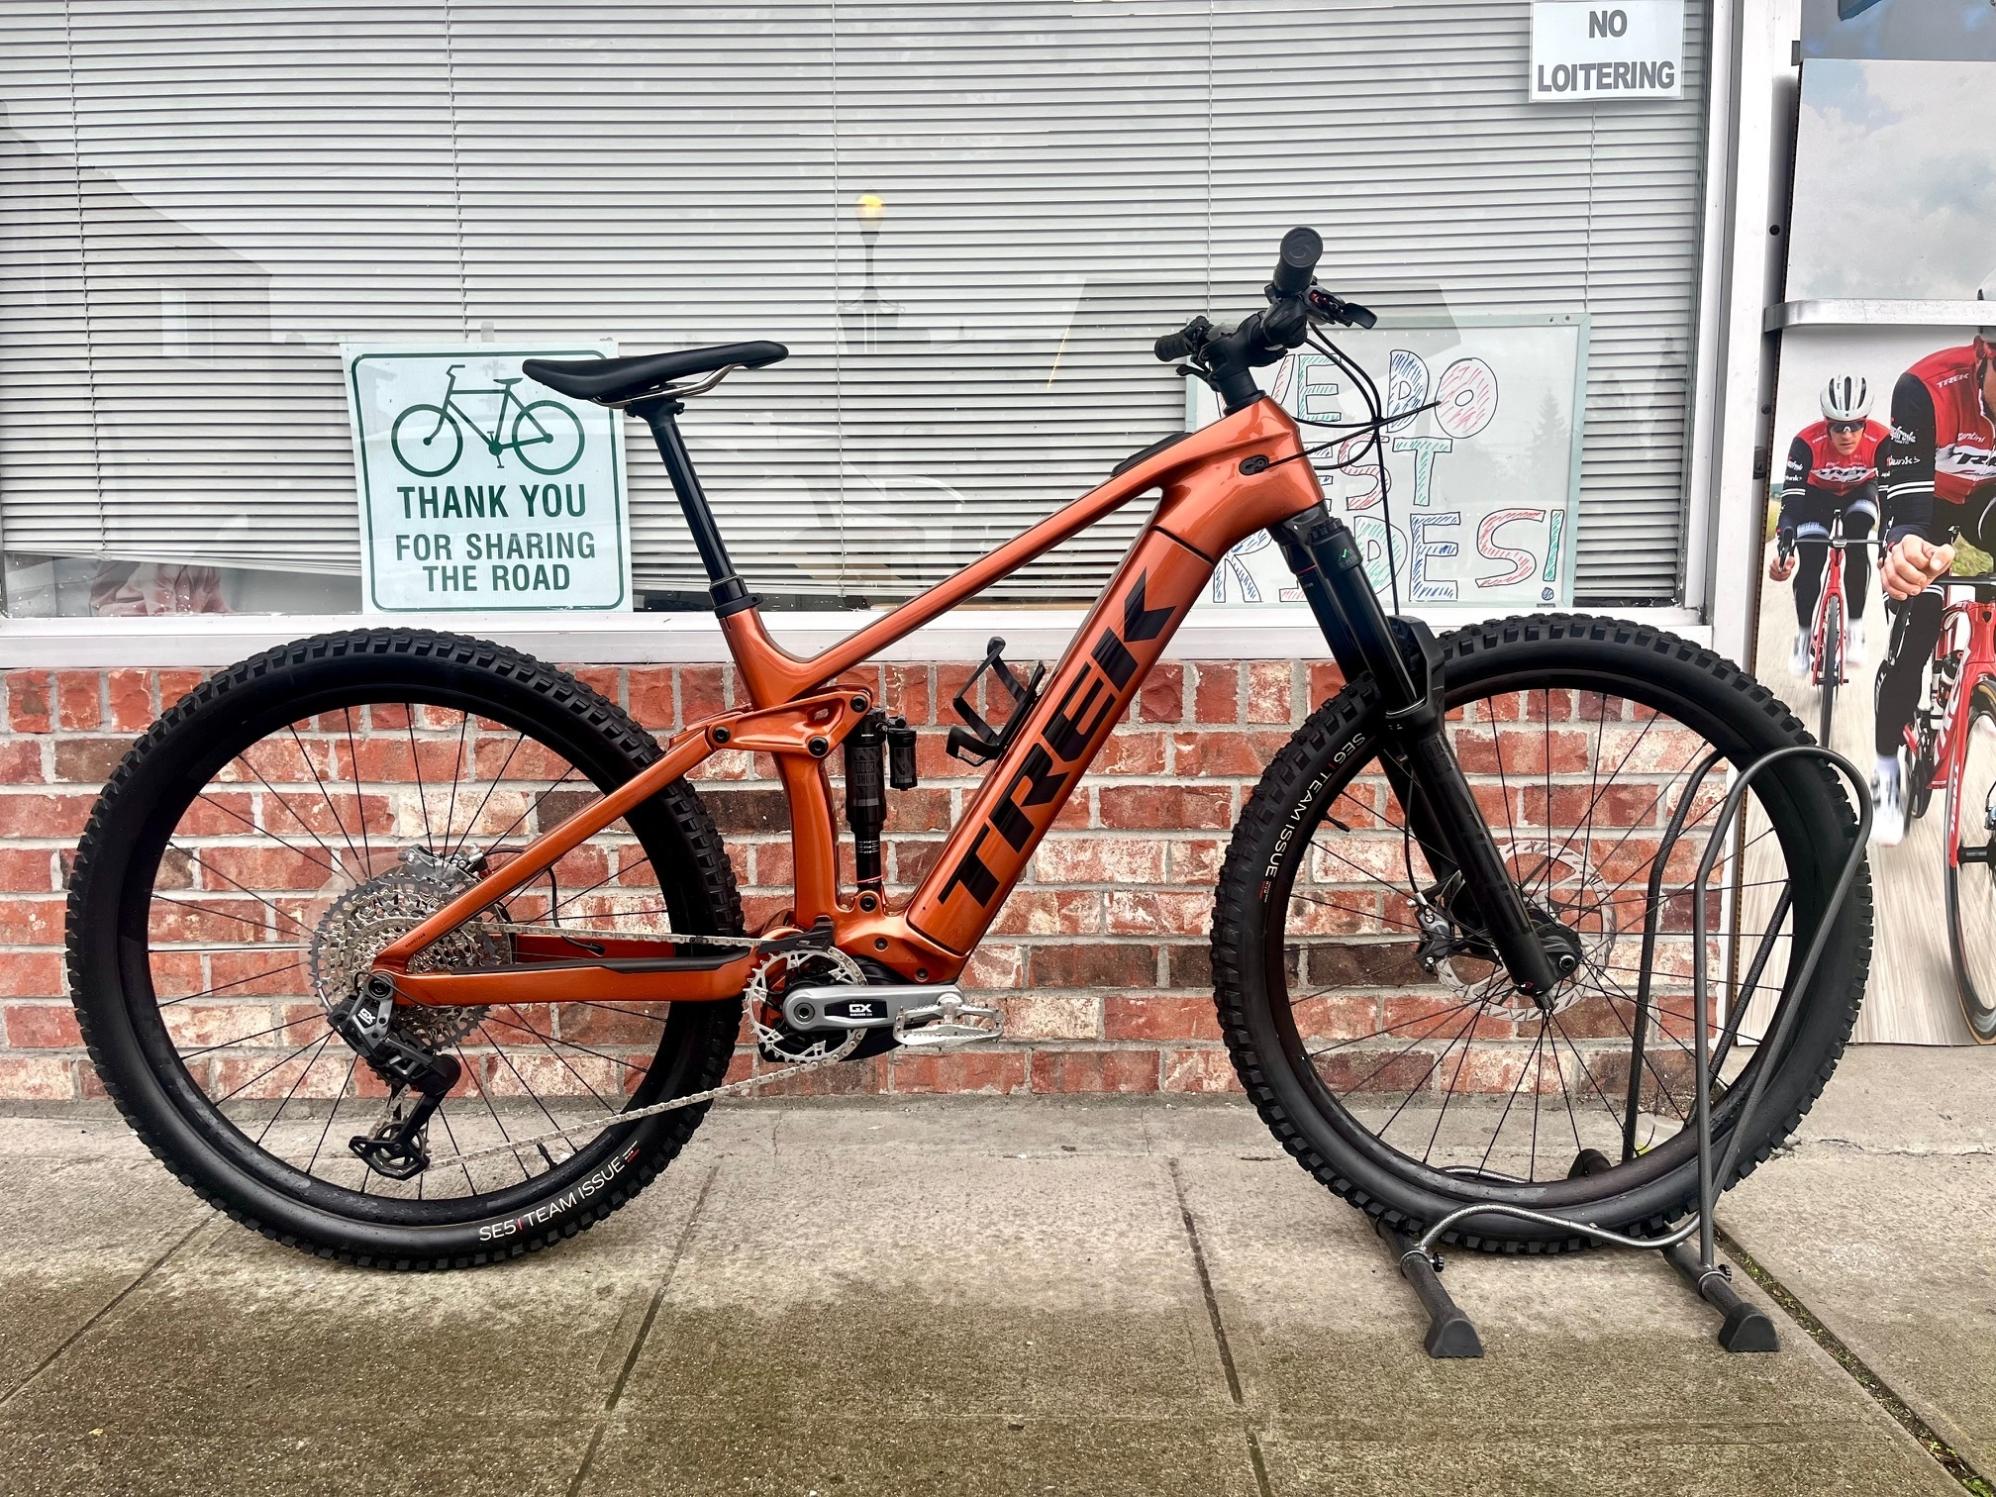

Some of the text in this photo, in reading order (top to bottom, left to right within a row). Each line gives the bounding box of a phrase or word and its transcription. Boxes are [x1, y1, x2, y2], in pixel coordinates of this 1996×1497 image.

[1588, 9, 1628, 38] NO
[1537, 60, 1675, 92] LOITERING
[1387, 348, 1498, 439] DO
[1936, 373, 1969, 388] TREK
[397, 484, 587, 519] THANK YOU
[396, 531, 596, 561] FOR SHARING
[422, 563, 571, 592] THE ROAD
[937, 566, 1178, 909] TREK
[1265, 732, 1366, 878] SE6 TEAM ISSUE
[848, 1003, 873, 1013] GX
[479, 1155, 626, 1242] SE5 TEAM ISSUE
